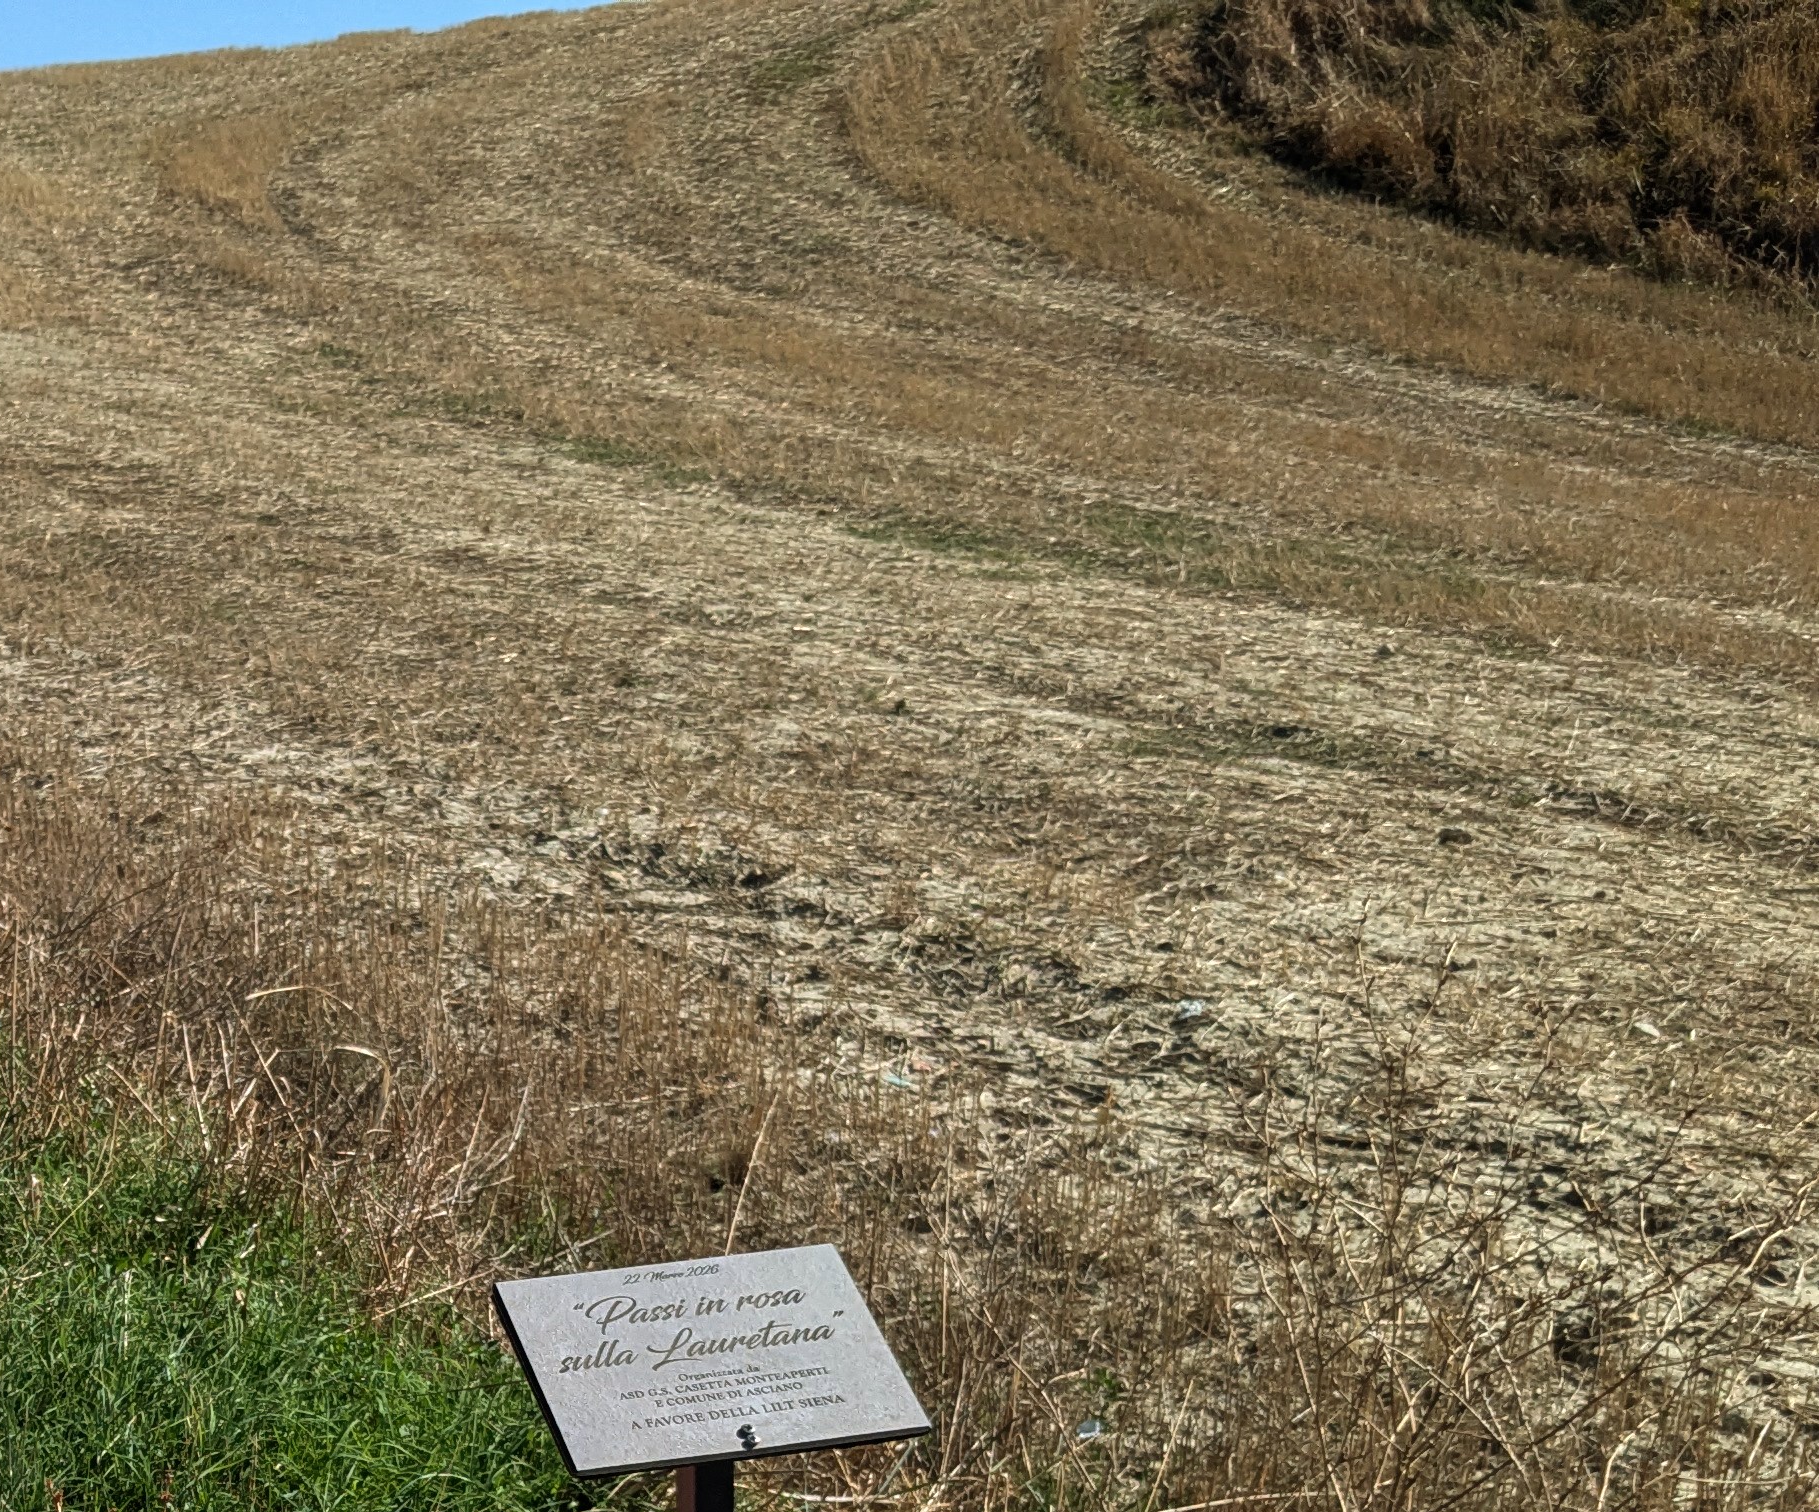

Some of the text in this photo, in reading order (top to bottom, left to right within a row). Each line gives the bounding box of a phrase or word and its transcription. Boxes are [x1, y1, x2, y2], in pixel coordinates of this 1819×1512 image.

[623, 1274, 641, 1286] 22
[685, 1264, 720, 1277] 2026
[695, 1296, 729, 1316] in
[736, 1289, 806, 1312] rosa
[559, 1339, 639, 1373] sulla
[746, 1364, 760, 1373] da
[620, 1367, 829, 1400] ASD G.S. CASETTA MONTEAPERTI
[655, 1381, 803, 1408] E COMUNE DI ASCIANO
[632, 1394, 845, 1430] A FAVORE DELLA LILT SIENA
